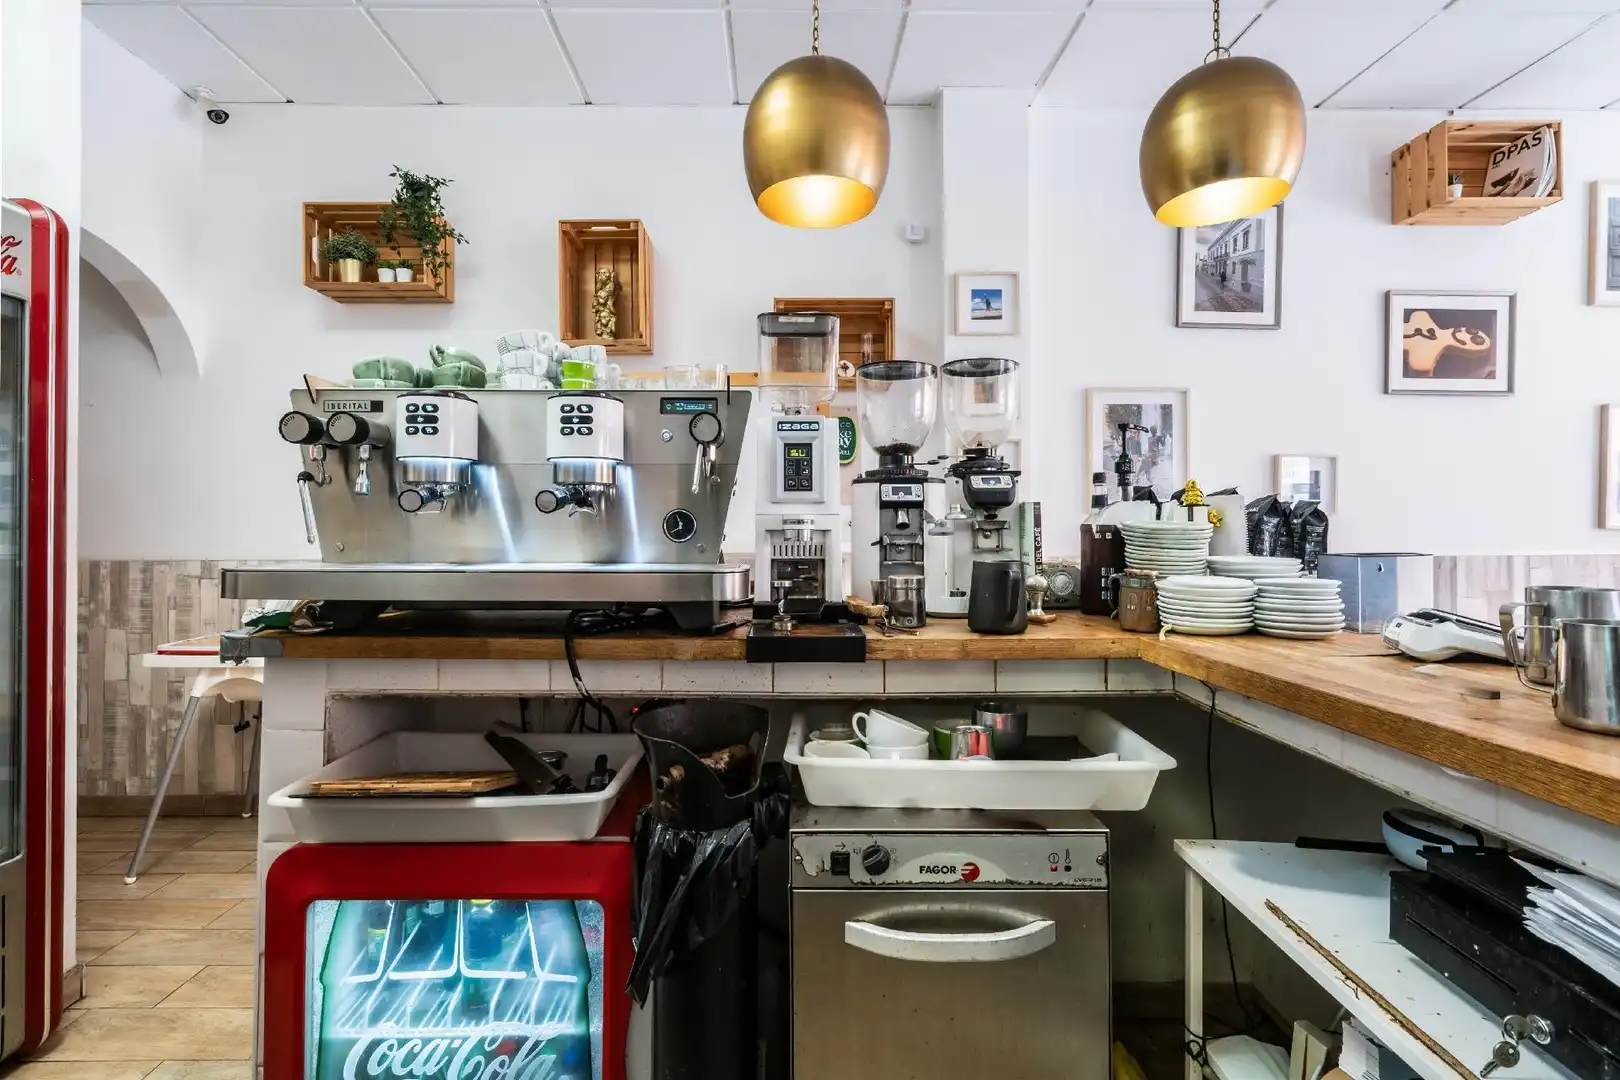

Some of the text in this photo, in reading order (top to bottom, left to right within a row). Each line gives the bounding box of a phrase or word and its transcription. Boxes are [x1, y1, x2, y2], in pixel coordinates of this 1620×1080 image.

[1492, 131, 1542, 166] DPAS
[327, 402, 368, 410] IBERITAL
[919, 865, 957, 875] FAGOR
